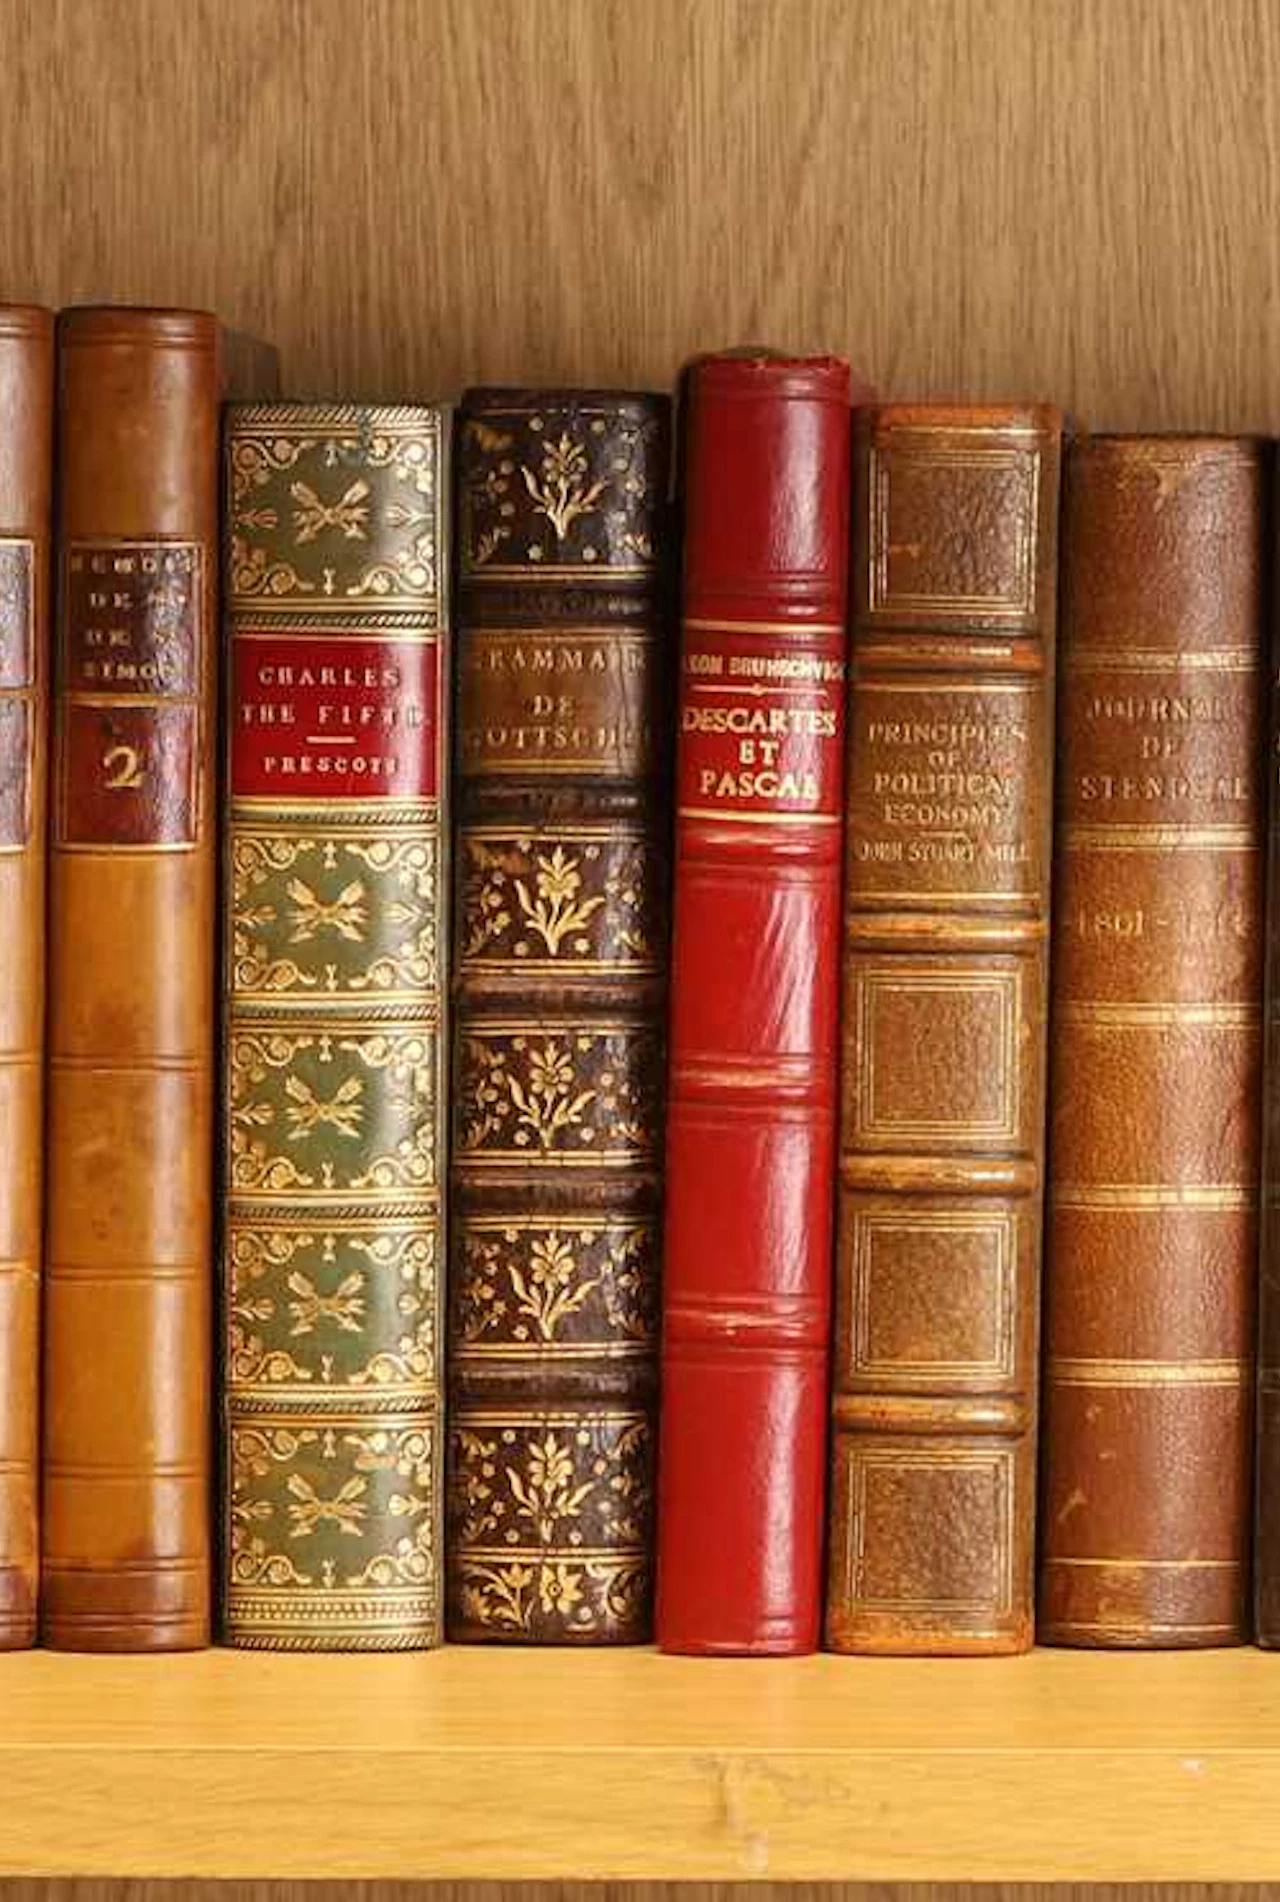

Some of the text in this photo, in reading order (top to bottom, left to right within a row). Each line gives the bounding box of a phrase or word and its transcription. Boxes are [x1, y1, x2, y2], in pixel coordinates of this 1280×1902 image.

[258, 666, 401, 688] CHARLES
[241, 703, 296, 724] THE
[533, 694, 575, 717] DE
[683, 707, 837, 737] DESCARTES
[868, 721, 1029, 746] PRINCIPLES
[264, 755, 400, 774] PRESCOTT
[739, 739, 780, 765] ET
[928, 751, 962, 767] OF
[104, 746, 142, 787] 2
[699, 769, 821, 801] PASCAL
[873, 771, 1020, 798] POLITICAL
[884, 801, 1007, 826] ECONOMY
